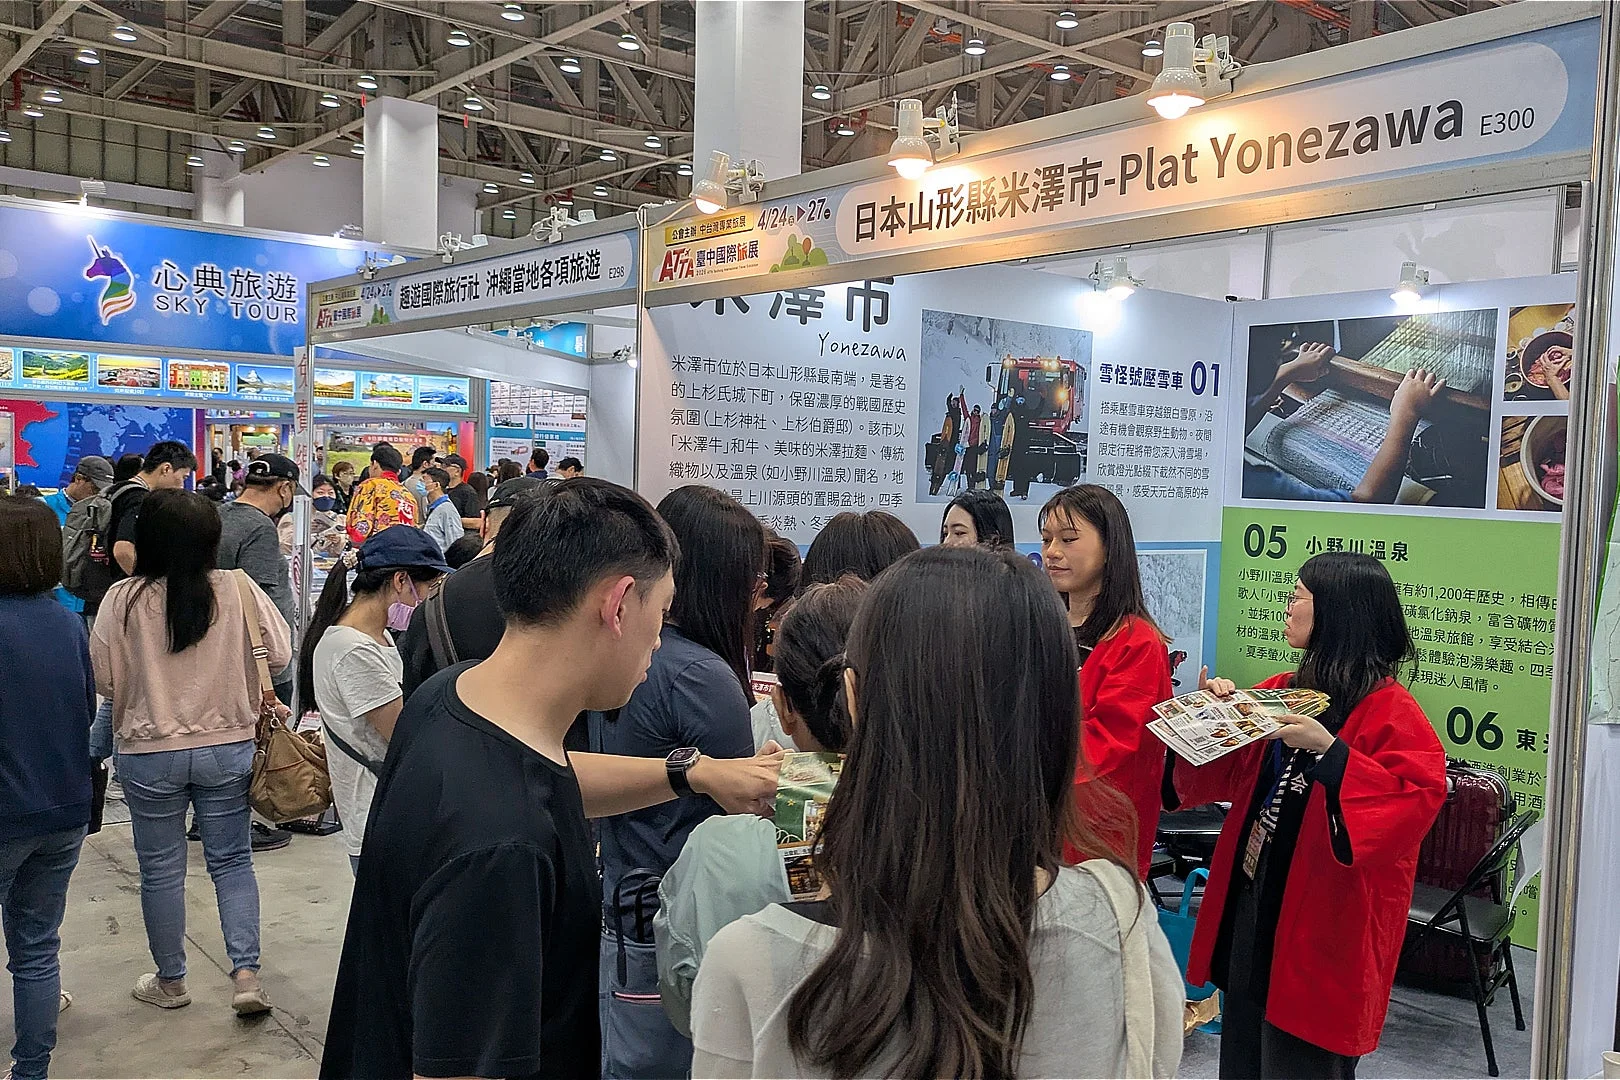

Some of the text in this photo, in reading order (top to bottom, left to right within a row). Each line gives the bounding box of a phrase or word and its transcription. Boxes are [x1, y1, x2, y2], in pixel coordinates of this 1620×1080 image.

[854, 98, 1535, 243] 日本山形縣米澤市-Plat Yonezawa E300
[154, 262, 296, 303] 心典旅遊
[400, 272, 480, 310] 趣遊國際旅行社
[486, 250, 600, 297] 沖繩當地各項旅遊
[609, 267, 624, 279] E298
[156, 296, 296, 322] SKY TOUR
[818, 332, 906, 361] Yonezawa
[671, 355, 906, 391] 米澤市位於日本山形縣最南端，是著名
[1100, 361, 1220, 396] 雪怪號壓雪車 01
[671, 381, 906, 414] 的上杉氏城下町，保留濃厚的戰國歷史
[1243, 523, 1408, 561] 05 小野川溫泉
[1446, 706, 1549, 753] 06 東
